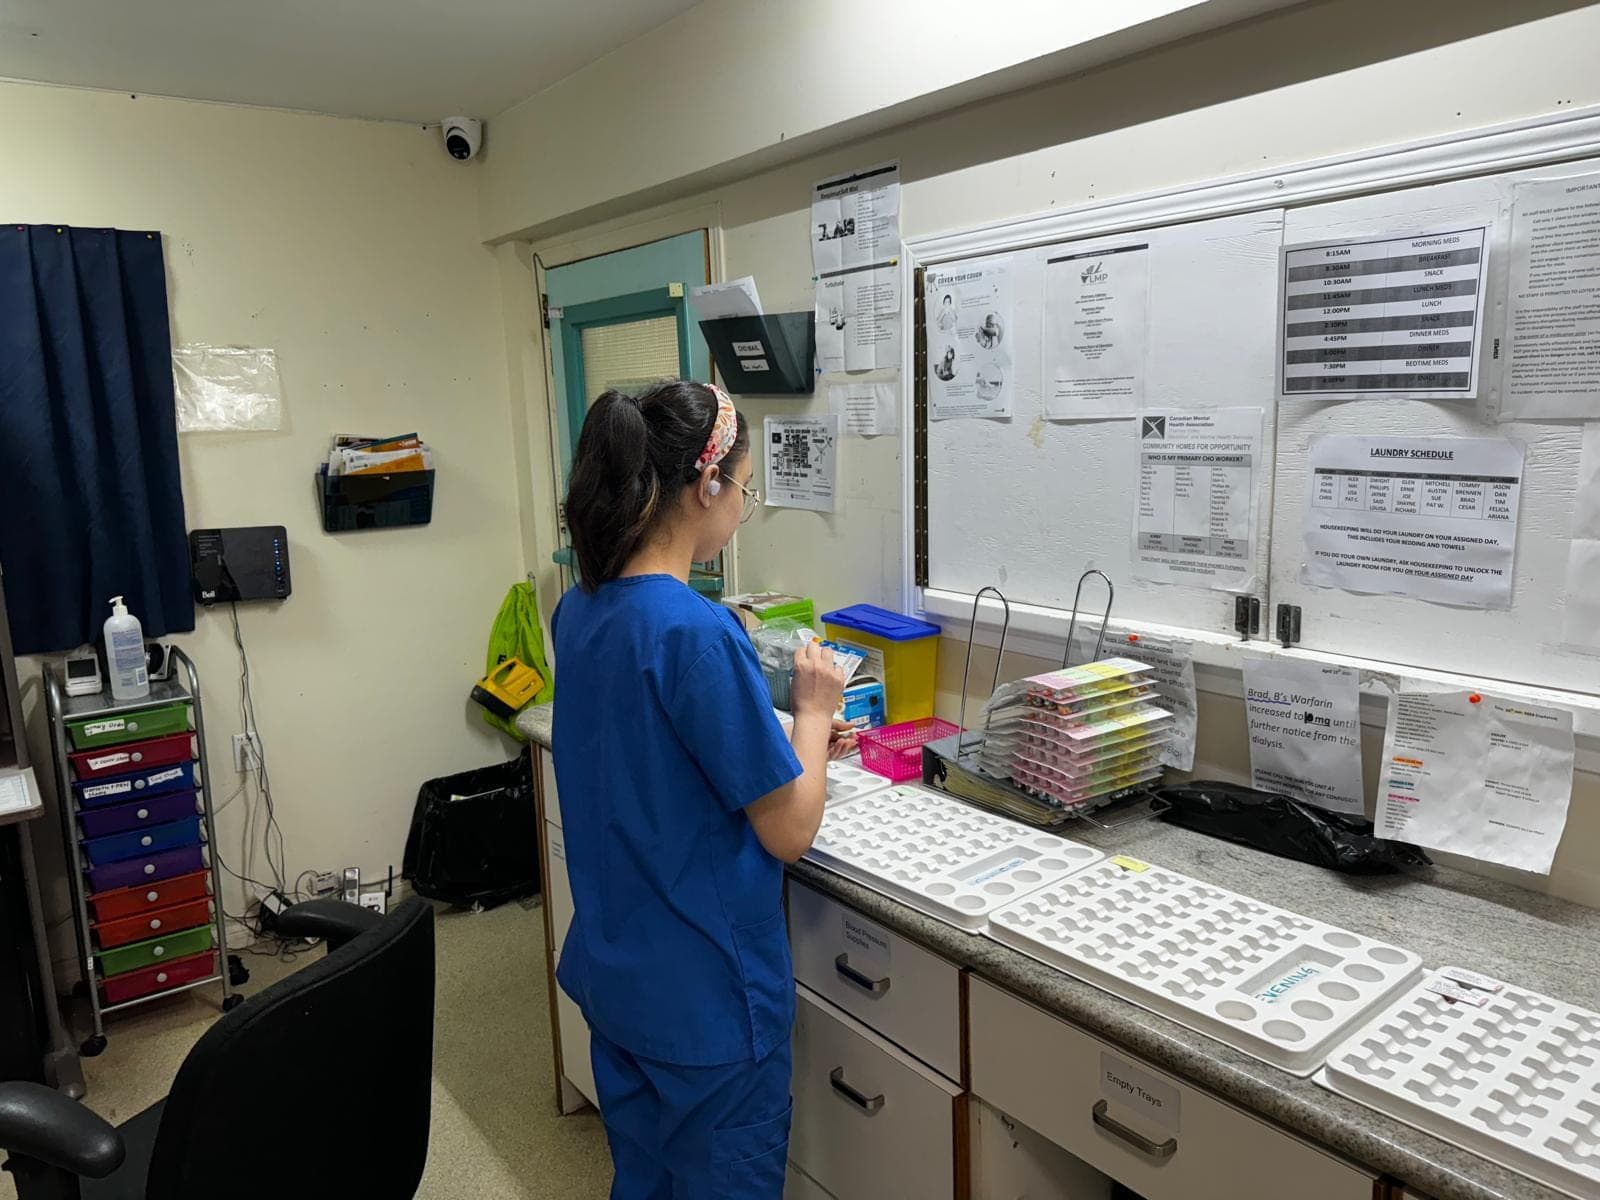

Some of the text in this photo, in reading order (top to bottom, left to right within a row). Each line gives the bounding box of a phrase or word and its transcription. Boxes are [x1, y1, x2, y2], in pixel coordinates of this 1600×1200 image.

[1412, 236, 1460, 248] MORNING MEDS
[1418, 254, 1450, 263] BREAKFAST
[1090, 273, 1108, 283] LMP
[1370, 448, 1454, 458] LAUNDRY SCHEDULE
[1410, 562, 1453, 571] HOUSEKEEPING
[1431, 572, 1459, 580] ASSIGNED
[202, 590, 215, 598] Bell
[1248, 688, 1271, 700] Brad,
[1290, 694, 1333, 708] Warfarin
[1249, 704, 1292, 718] increased
[1294, 712, 1304, 720] to
[1315, 716, 1331, 727] mg
[1333, 719, 1356, 729] until
[1250, 719, 1356, 746] further notice from the
[1252, 736, 1285, 749] dialysis.
[1106, 1071, 1162, 1107] Empty Trays
